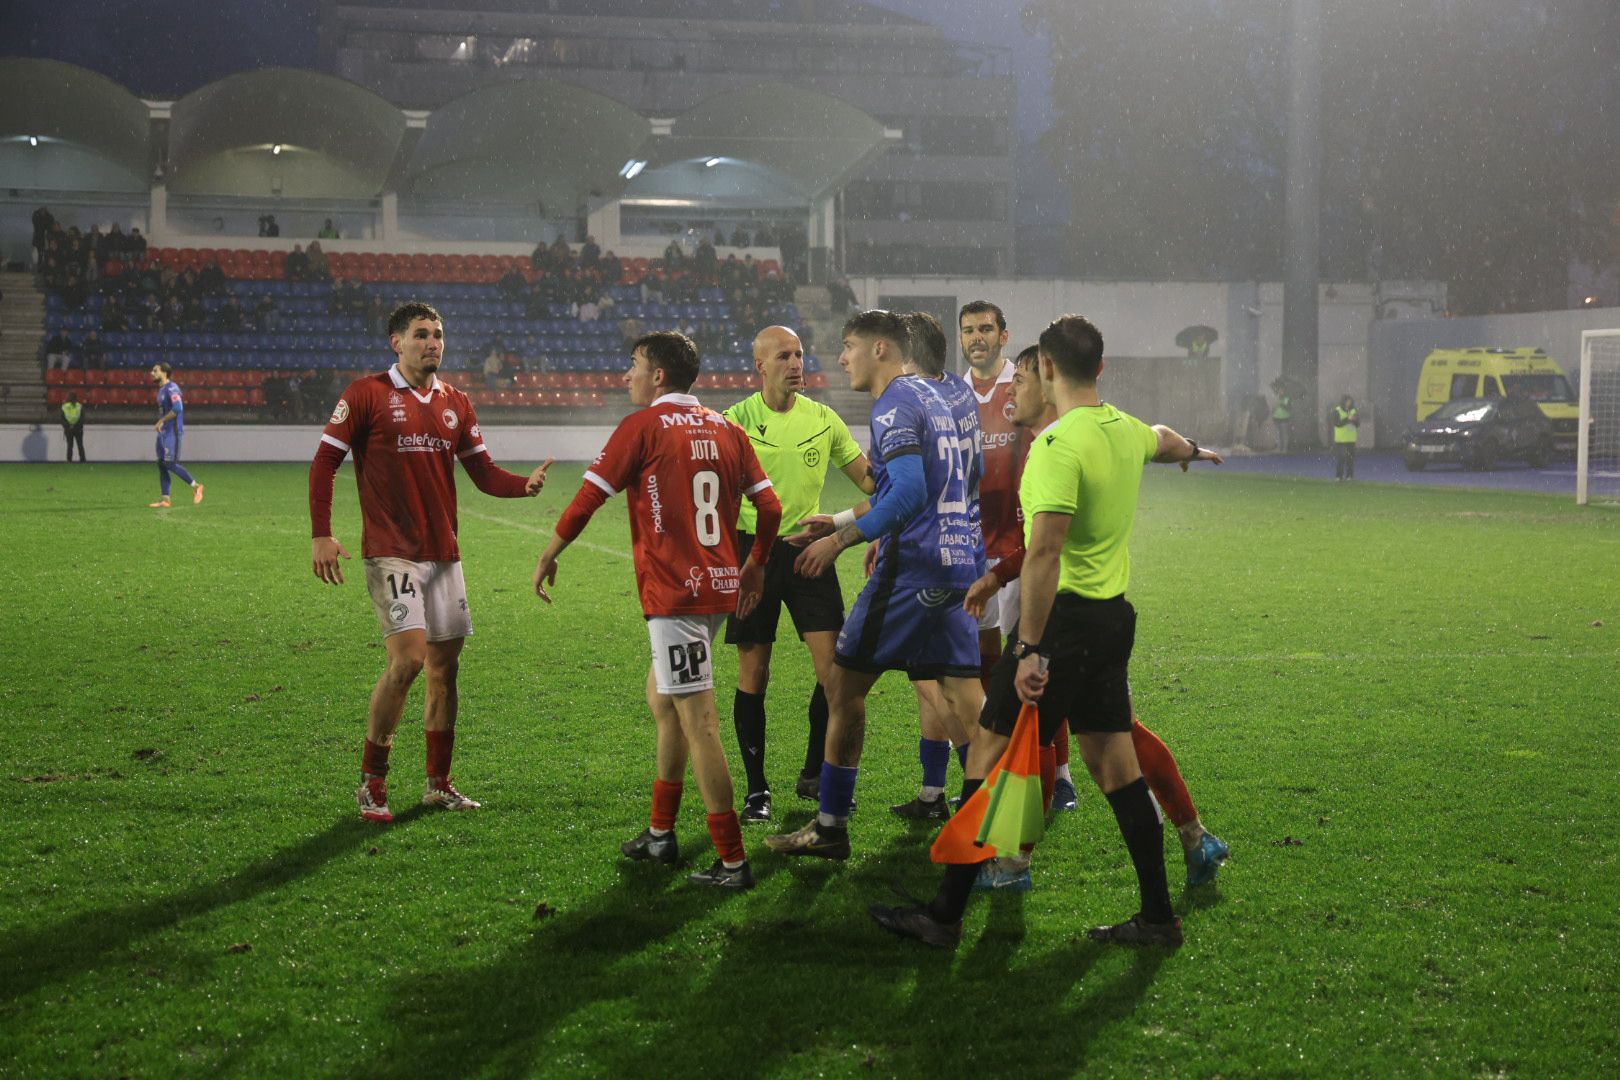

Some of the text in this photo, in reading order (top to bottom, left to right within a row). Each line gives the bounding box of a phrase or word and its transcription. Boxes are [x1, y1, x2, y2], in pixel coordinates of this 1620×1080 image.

[659, 412, 704, 429] MMG
[398, 433, 452, 451] telefurgo
[690, 439, 719, 460] JOTA
[692, 470, 721, 547] 8
[387, 573, 416, 600] 14
